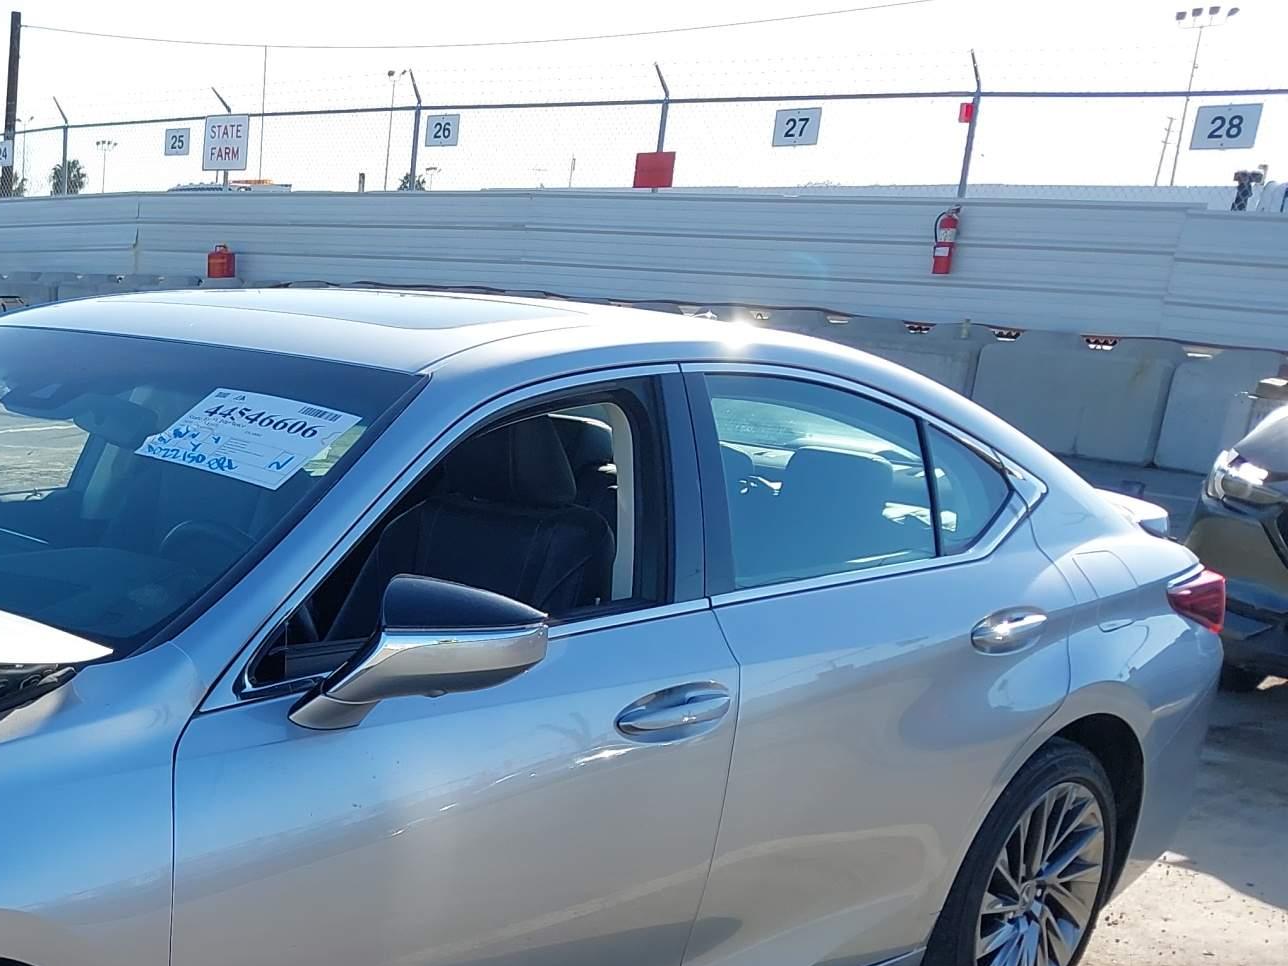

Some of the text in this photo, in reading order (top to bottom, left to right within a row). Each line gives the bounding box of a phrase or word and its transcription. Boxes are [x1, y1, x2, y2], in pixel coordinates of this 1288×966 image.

[209, 124, 243, 140] STATE
[433, 121, 452, 140] 26
[784, 117, 811, 138] 27
[1207, 114, 1245, 139] 28
[170, 134, 185, 150] 25
[209, 146, 240, 162] FARM
[203, 403, 326, 439] 44546606
